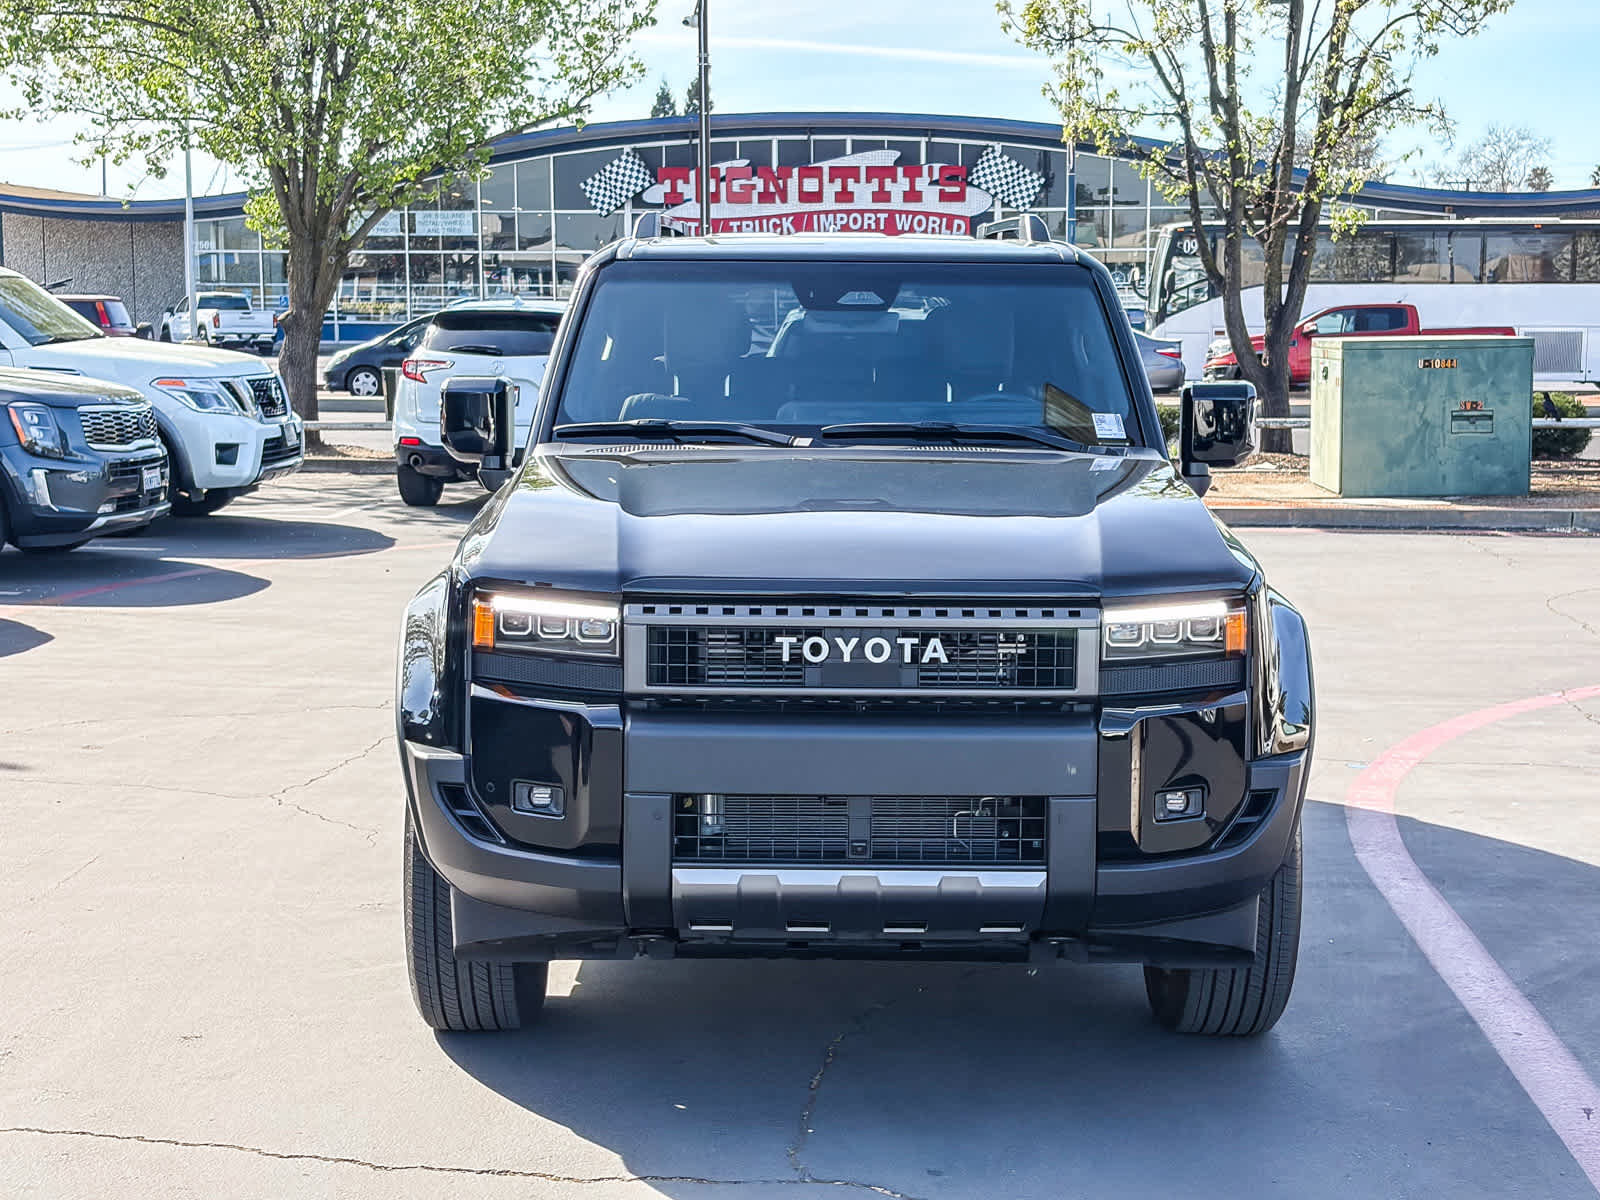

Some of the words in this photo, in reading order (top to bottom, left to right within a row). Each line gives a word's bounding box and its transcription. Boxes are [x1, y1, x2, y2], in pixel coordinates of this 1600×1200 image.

[657, 165, 967, 205] TOGNOTTI'S
[729, 216, 796, 236] TRUCK
[813, 213, 888, 233] IMPORT
[895, 213, 966, 235] WORLD
[1418, 358, 1457, 369] U-10844
[775, 636, 949, 664] TOYOTA
